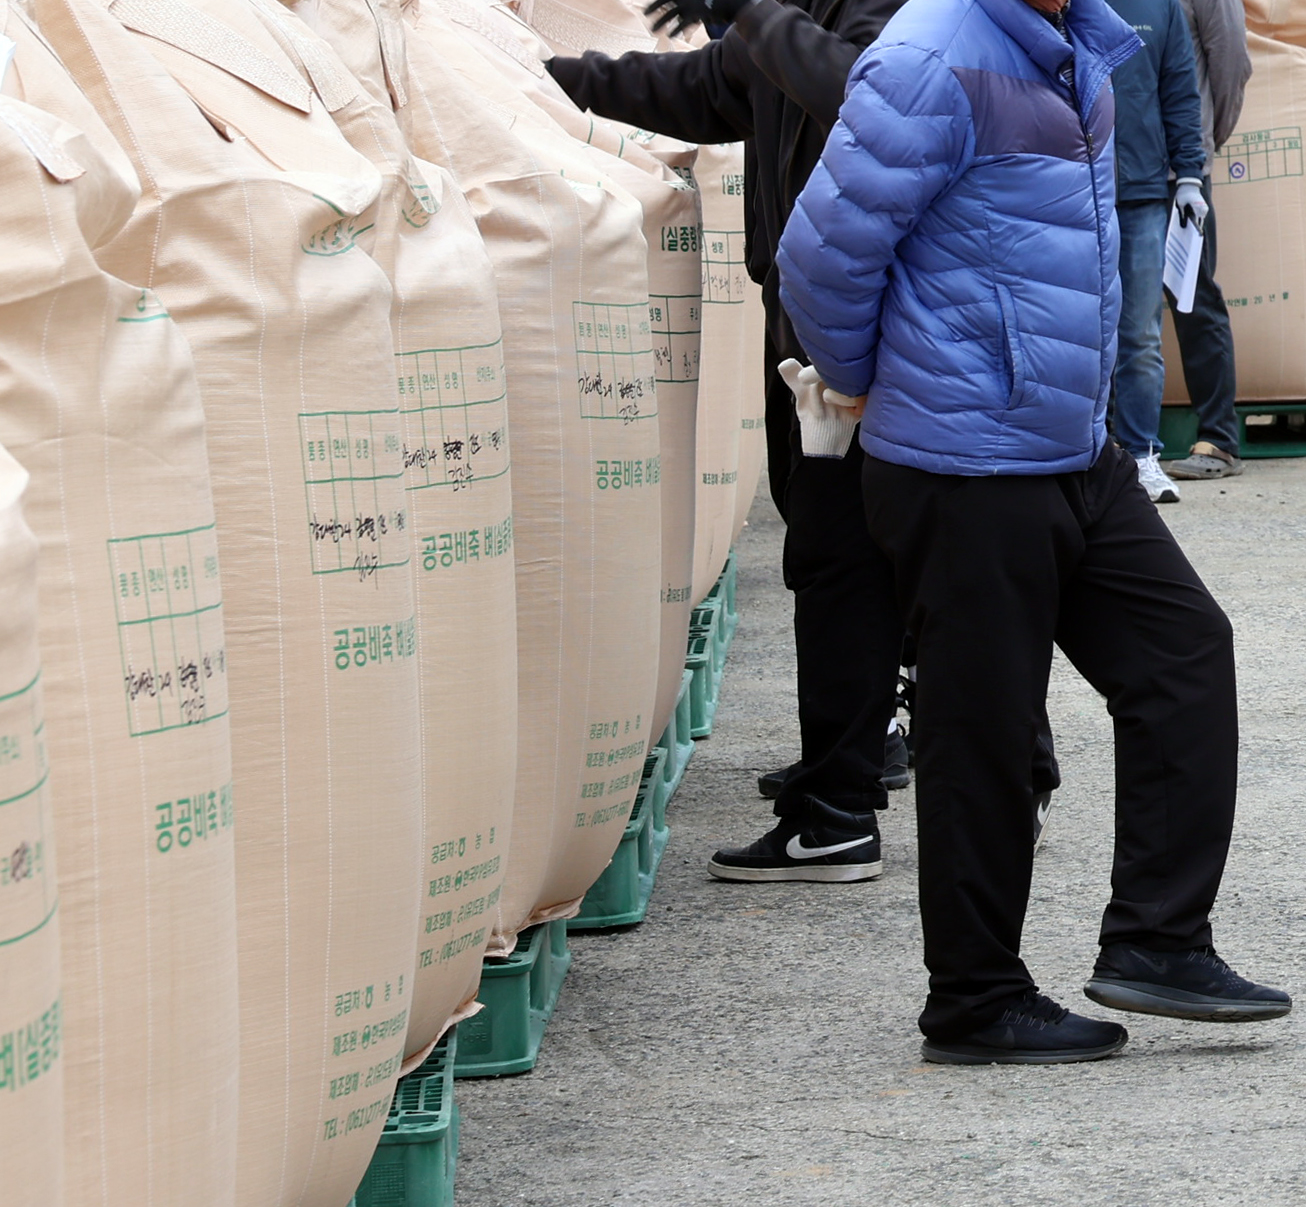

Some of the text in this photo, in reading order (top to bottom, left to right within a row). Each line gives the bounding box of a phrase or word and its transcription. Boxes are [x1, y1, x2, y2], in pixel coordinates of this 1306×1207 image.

[722, 174, 745, 196] [실중
[595, 459, 643, 490] 공공비축
[421, 528, 481, 572] 공공비축
[333, 623, 394, 671] 공공비축
[155, 789, 218, 853] 공공비축
